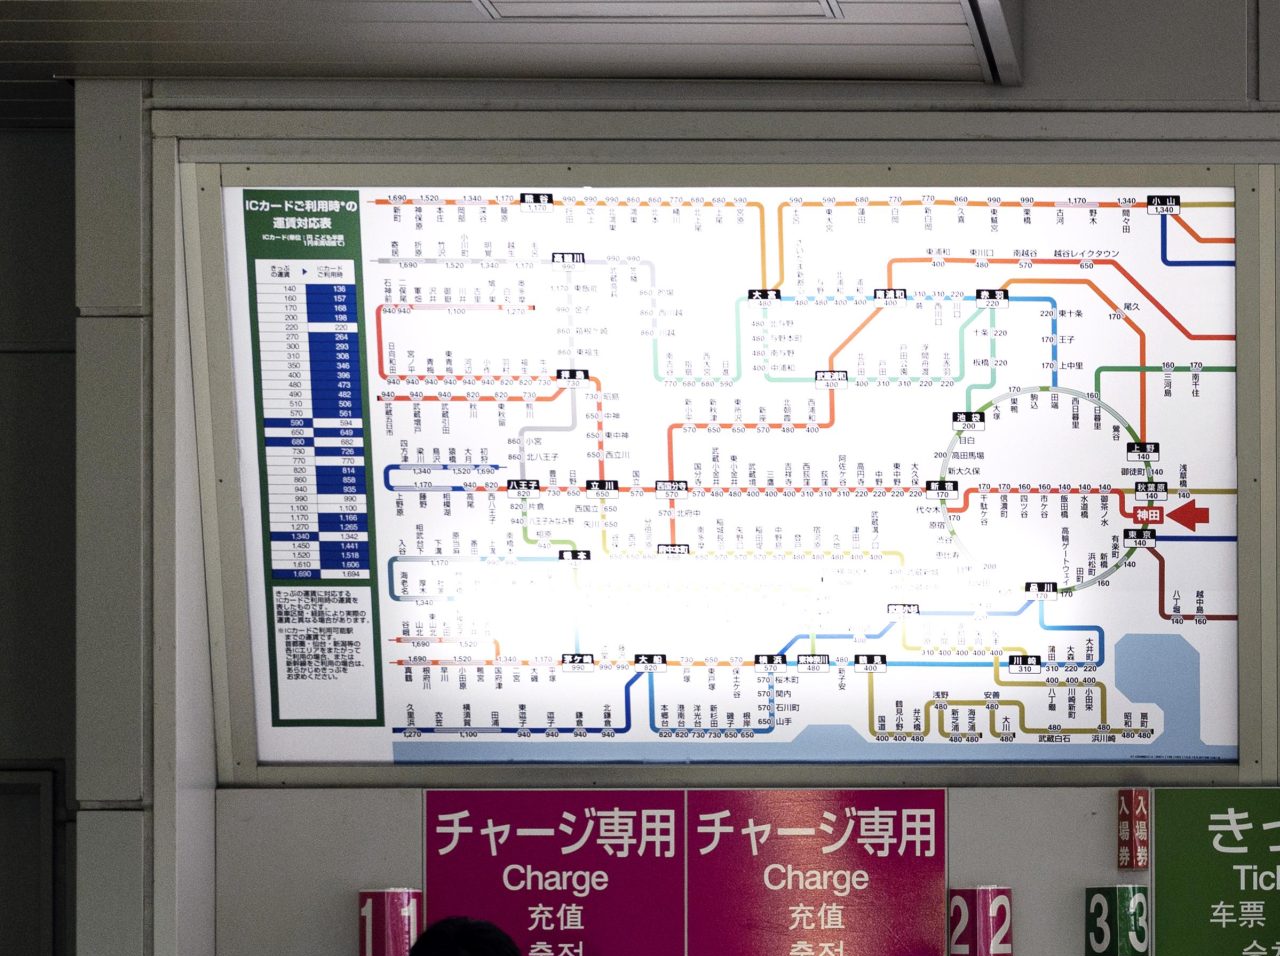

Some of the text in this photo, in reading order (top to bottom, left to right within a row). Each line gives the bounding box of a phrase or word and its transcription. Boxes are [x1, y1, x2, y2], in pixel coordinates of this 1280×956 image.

[1151, 196, 1176, 206] 小山
[1155, 206, 1174, 214] 1,340
[272, 217, 332, 229] 運賃対応表
[1053, 249, 1120, 258] 越谷レイクタウン
[951, 451, 985, 460] 高田馬場
[509, 481, 538, 490] 八王子
[1137, 482, 1166, 492] 秋葉原
[1136, 509, 1160, 520] 神田
[1038, 734, 1071, 743] 武蔵白石
[435, 808, 676, 859] チャージ専用
[696, 807, 936, 858] チャージ専用
[1118, 795, 1131, 868] 入場券
[1135, 794, 1148, 868] 入場券
[502, 865, 609, 898] Charge
[763, 864, 870, 897] Charge
[361, 898, 373, 956] 1
[527, 902, 585, 931] 充值
[788, 902, 846, 931] 充值
[951, 896, 970, 955] 2
[989, 895, 1013, 954] 2
[1089, 894, 1111, 953] 3
[1129, 892, 1148, 952] 3
[1210, 900, 1267, 929] 车票
